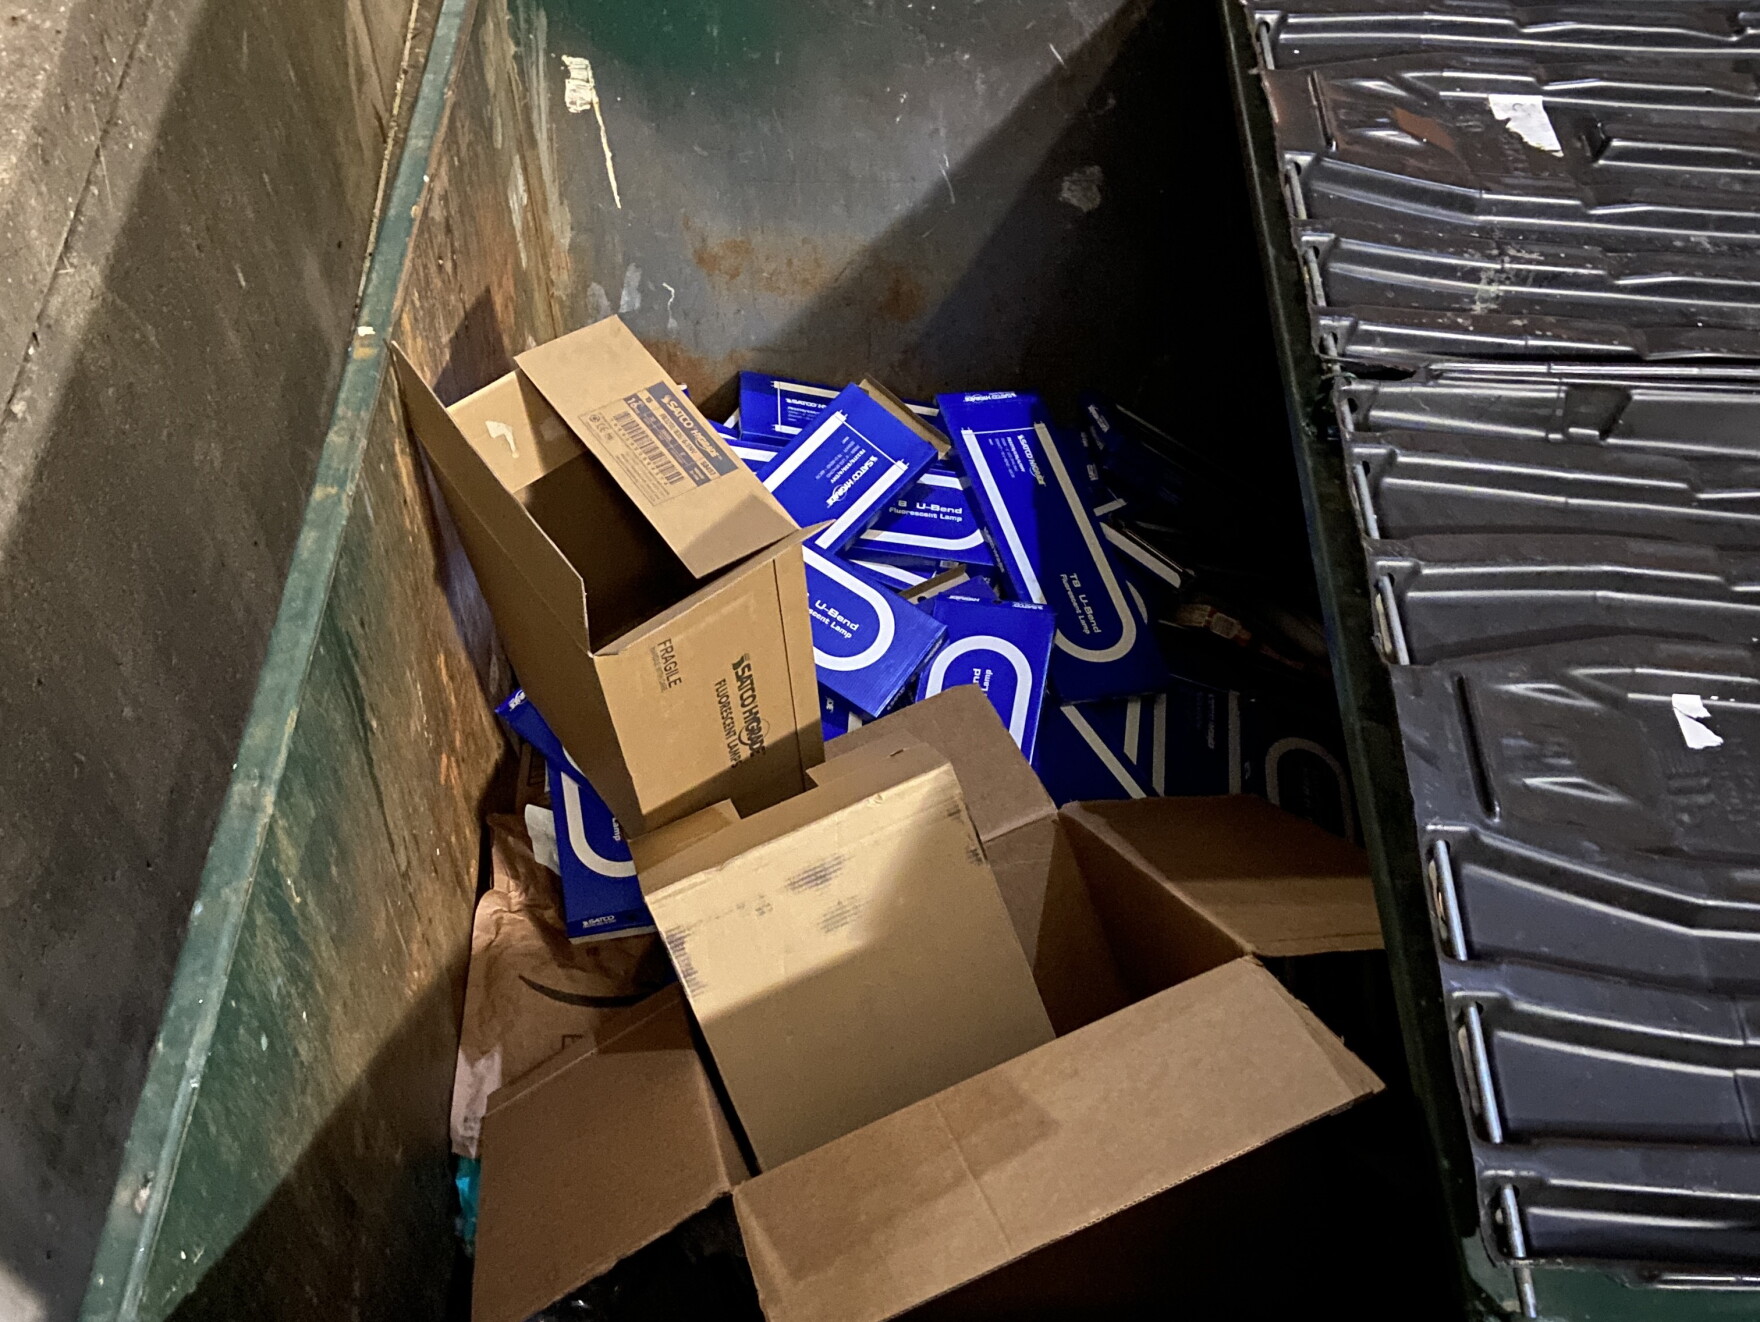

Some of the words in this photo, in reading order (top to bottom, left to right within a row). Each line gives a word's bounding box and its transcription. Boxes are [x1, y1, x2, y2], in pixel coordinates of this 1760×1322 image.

[667, 400, 694, 430] SATCO
[851, 460, 874, 482] SATCO
[889, 507, 938, 518] Fluorescent
[939, 513, 963, 522] Lamp
[916, 502, 963, 515] U-Bend
[815, 599, 860, 632] U-Bend
[1060, 573, 1082, 613] Fluorescent
[1078, 615, 1090, 635] Lamp
[1079, 594, 1102, 633] U-Bend
[830, 622, 853, 640] Lamp
[657, 638, 682, 689] FRAGILE
[735, 662, 755, 707] SATCO
[982, 669, 993, 692] Lamp
[714, 678, 737, 740] FLUORESCENT
[726, 738, 743, 769] LAMPS
[588, 915, 615, 926] SATCO
